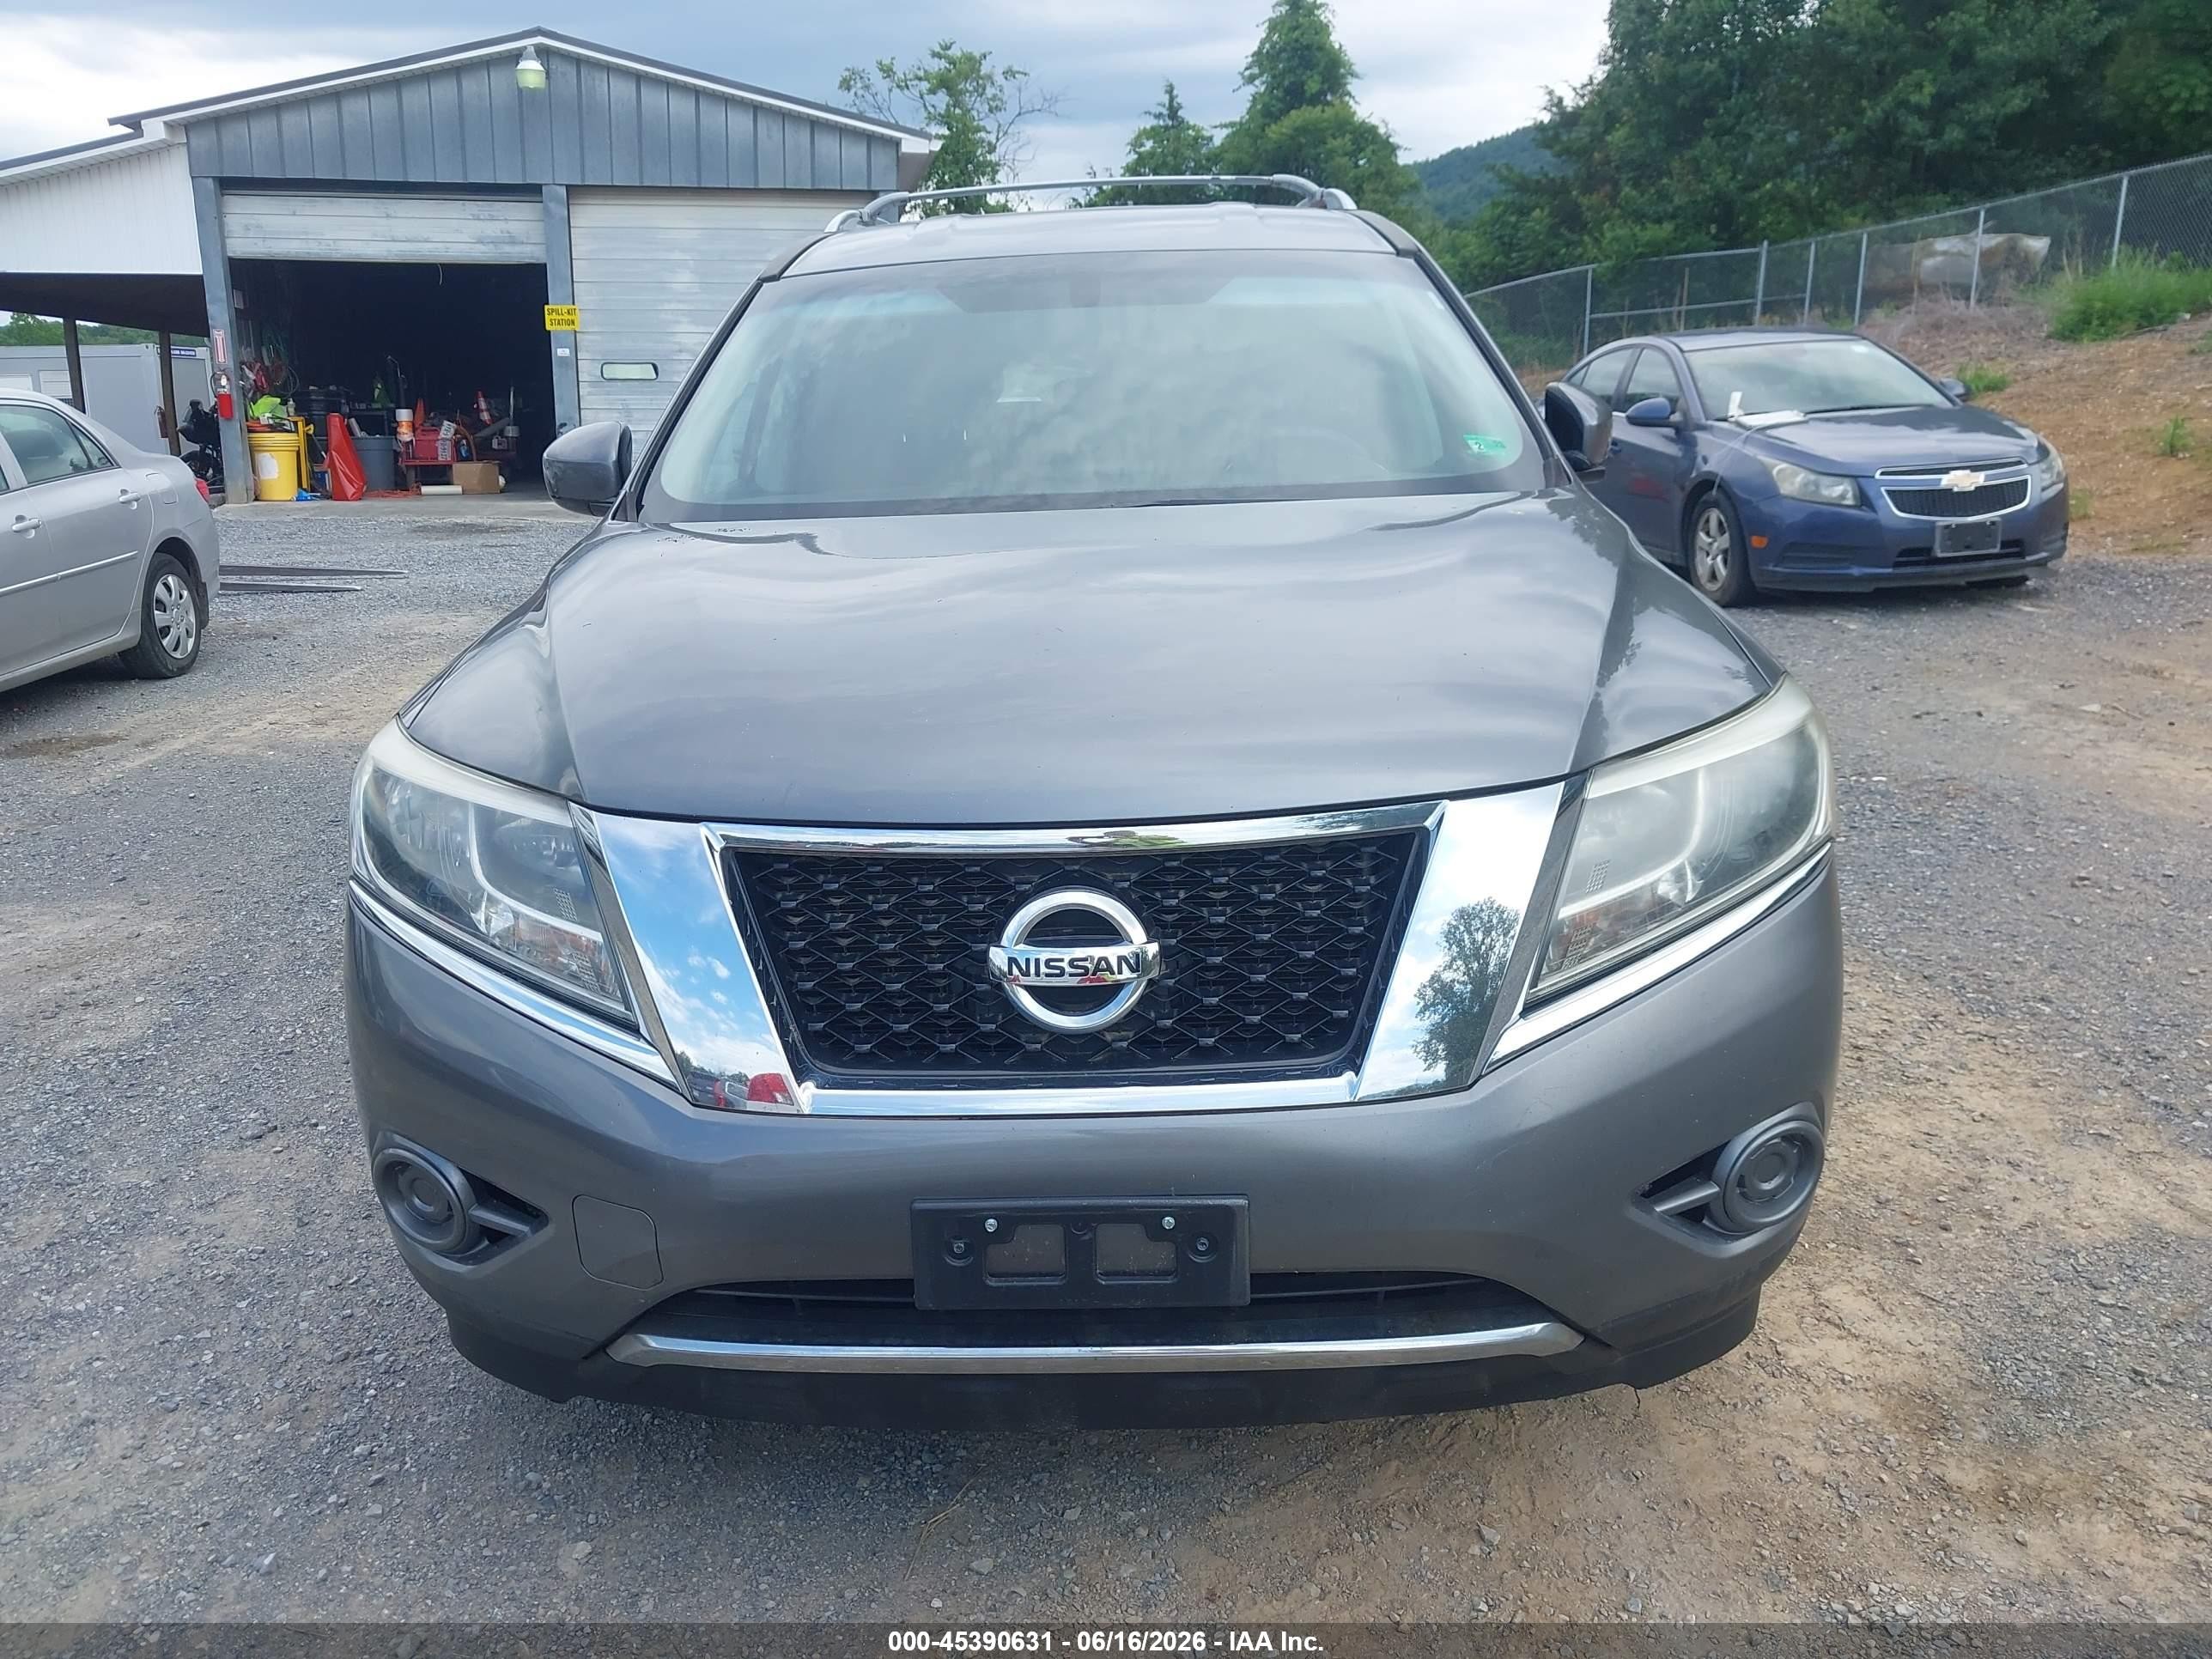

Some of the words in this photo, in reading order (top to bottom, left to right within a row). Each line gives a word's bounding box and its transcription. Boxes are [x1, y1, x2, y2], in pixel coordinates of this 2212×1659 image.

[546, 307, 577, 316] SPILL-KIT
[550, 318, 575, 326] STATION
[1007, 954, 1142, 978] NISSAN
